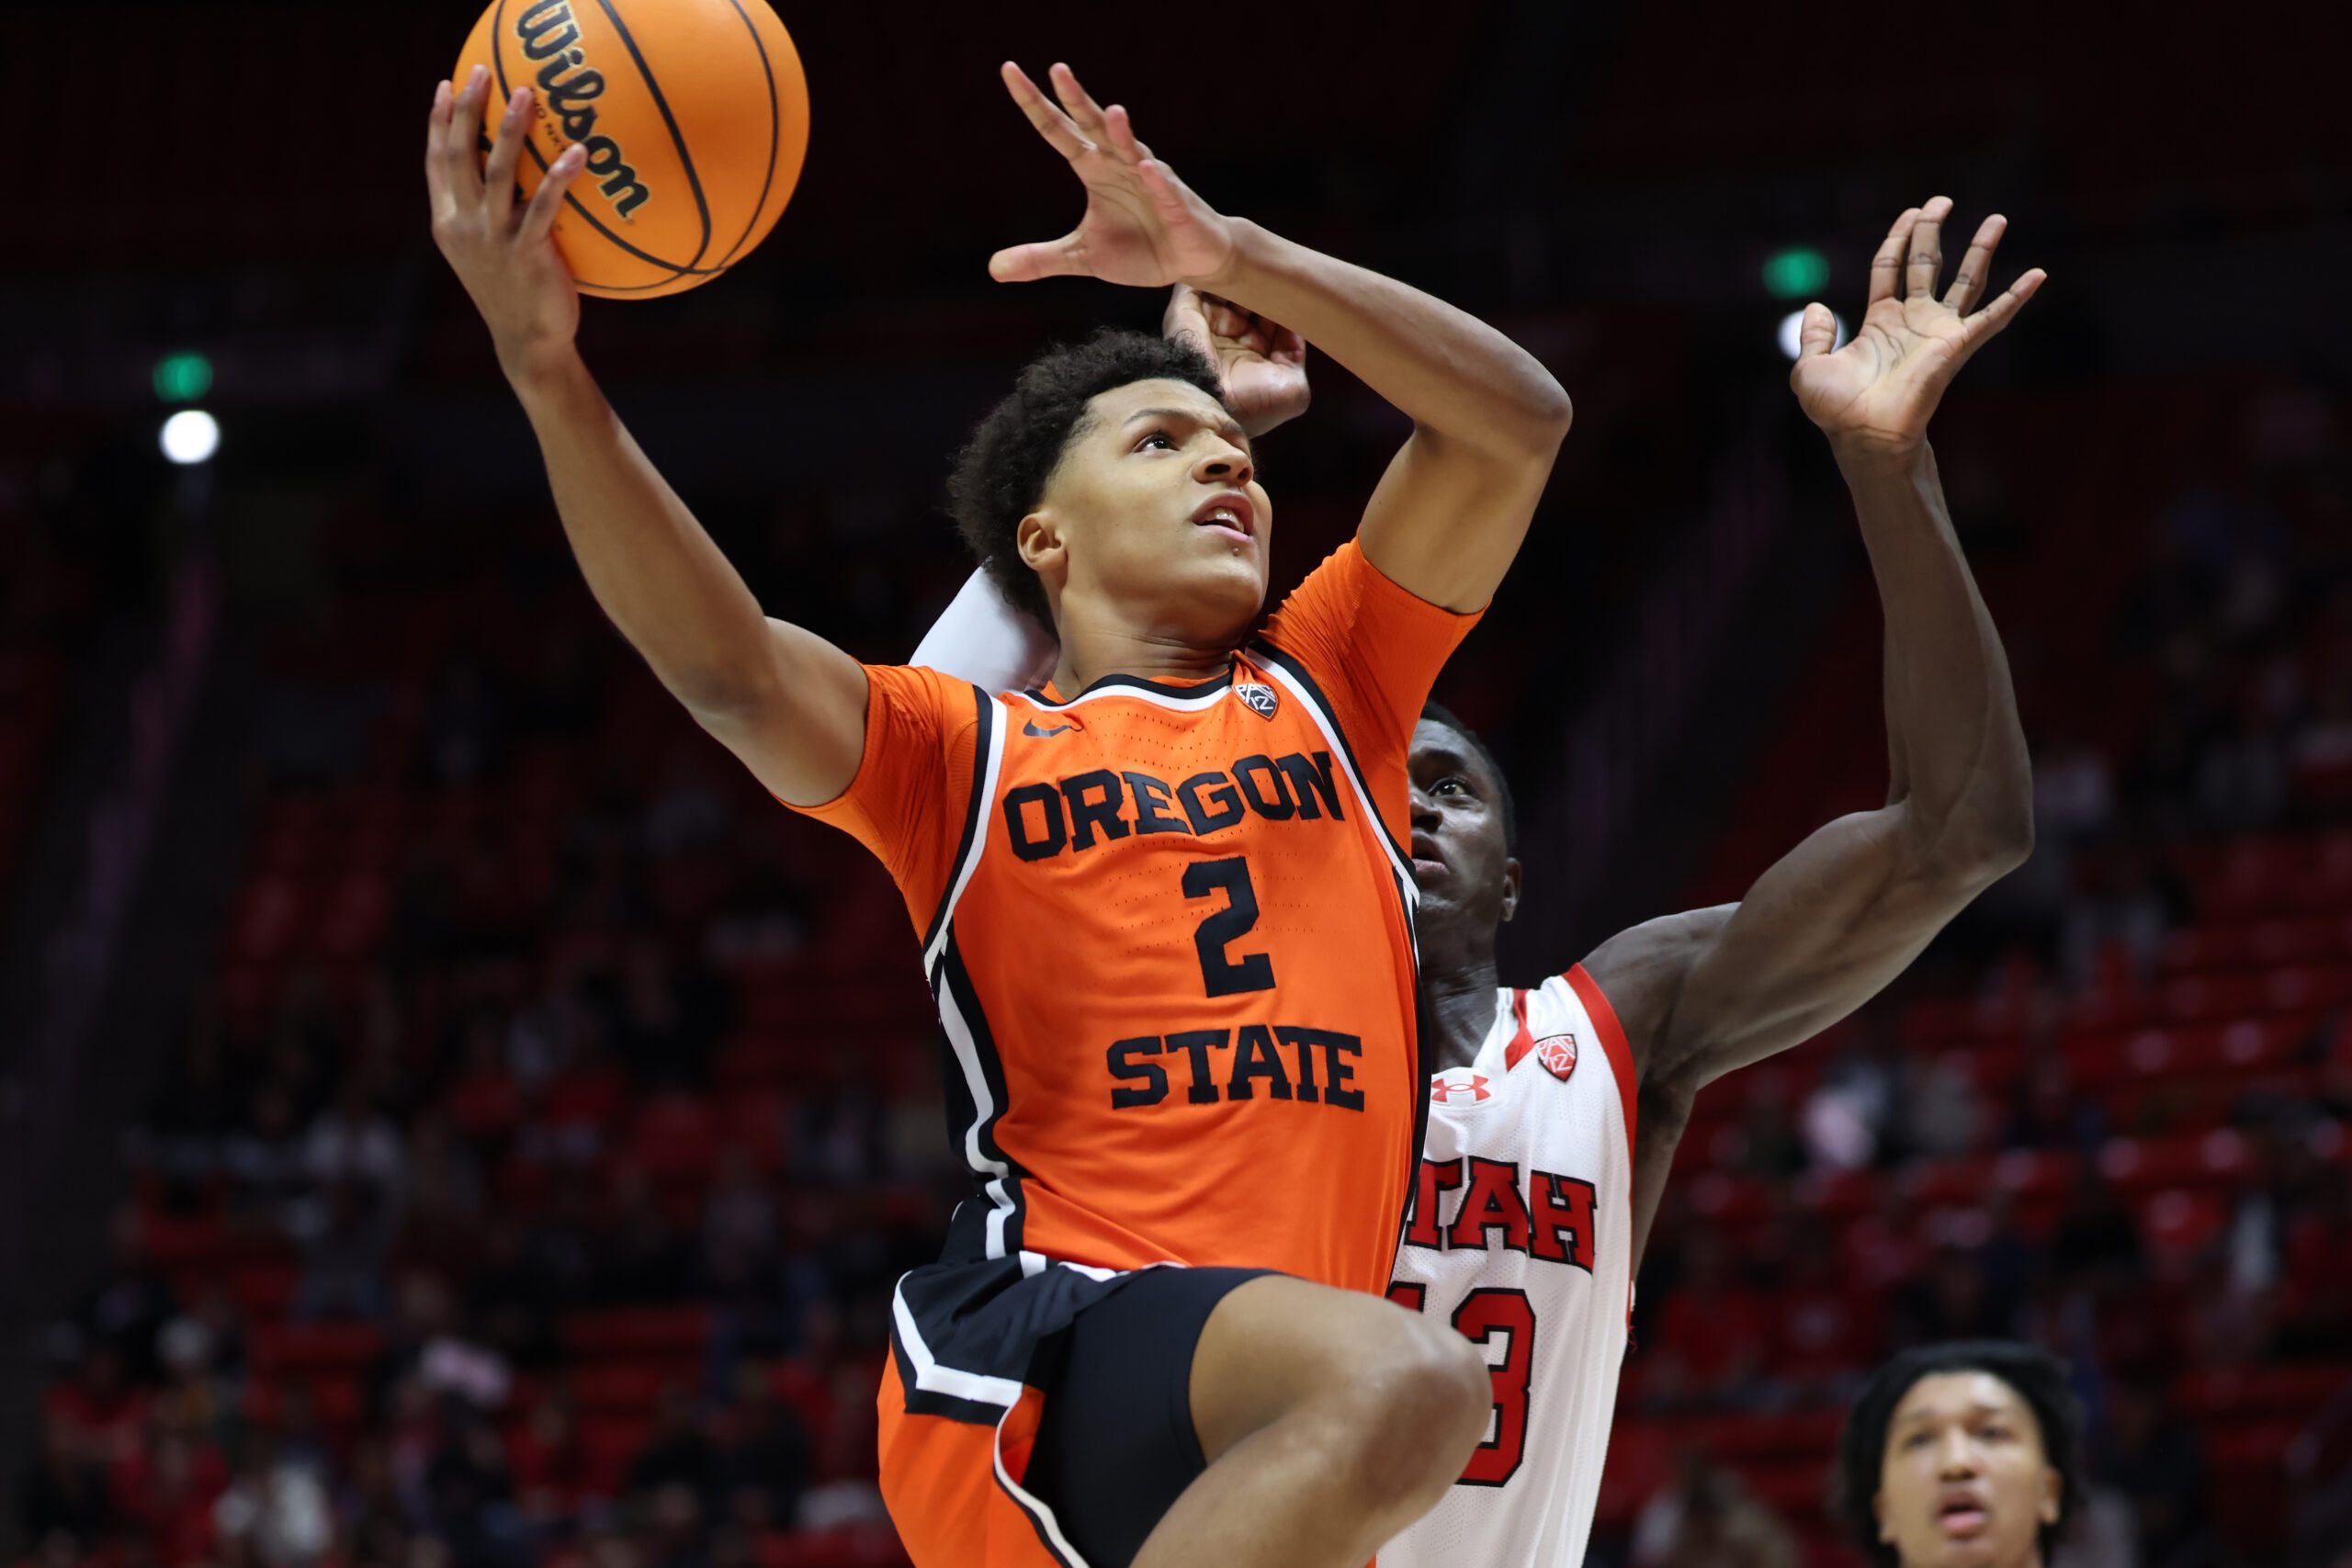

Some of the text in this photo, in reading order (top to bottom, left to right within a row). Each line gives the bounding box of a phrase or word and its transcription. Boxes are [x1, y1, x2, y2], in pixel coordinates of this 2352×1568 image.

[515, 0, 650, 219] Wilson
[1250, 695, 1274, 710] 12
[1003, 751, 1345, 862] OREGON
[1182, 856, 1276, 998] 2
[1106, 1025, 1364, 1111] STATE
[1549, 1053, 1573, 1073] 12
[1404, 1155, 1598, 1276] TAH
[1385, 1280, 1536, 1487] 3
